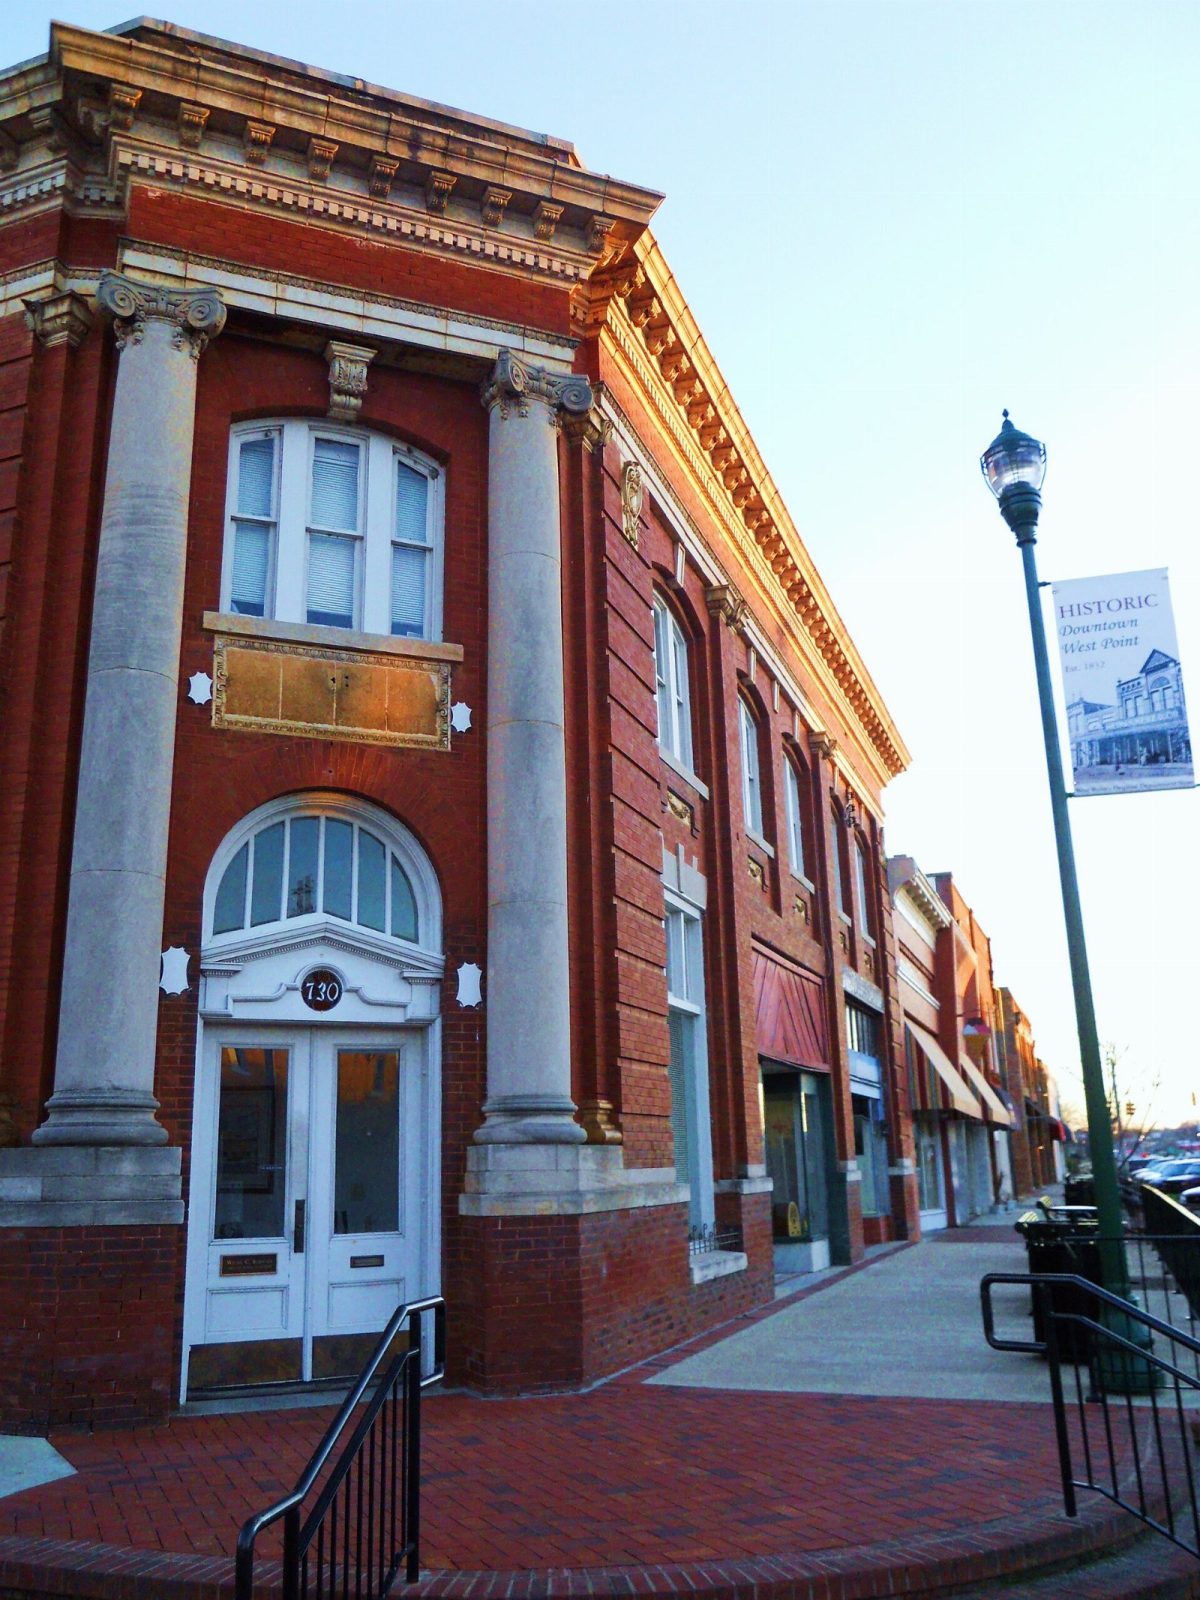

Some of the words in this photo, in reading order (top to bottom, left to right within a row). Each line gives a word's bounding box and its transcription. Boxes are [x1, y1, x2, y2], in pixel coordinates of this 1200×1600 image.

[1059, 594, 1158, 618] HISTORIC
[1061, 618, 1138, 636] Downtown
[1063, 640, 1096, 654] West
[1101, 635, 1139, 650] Point
[306, 982, 339, 1001] 730
